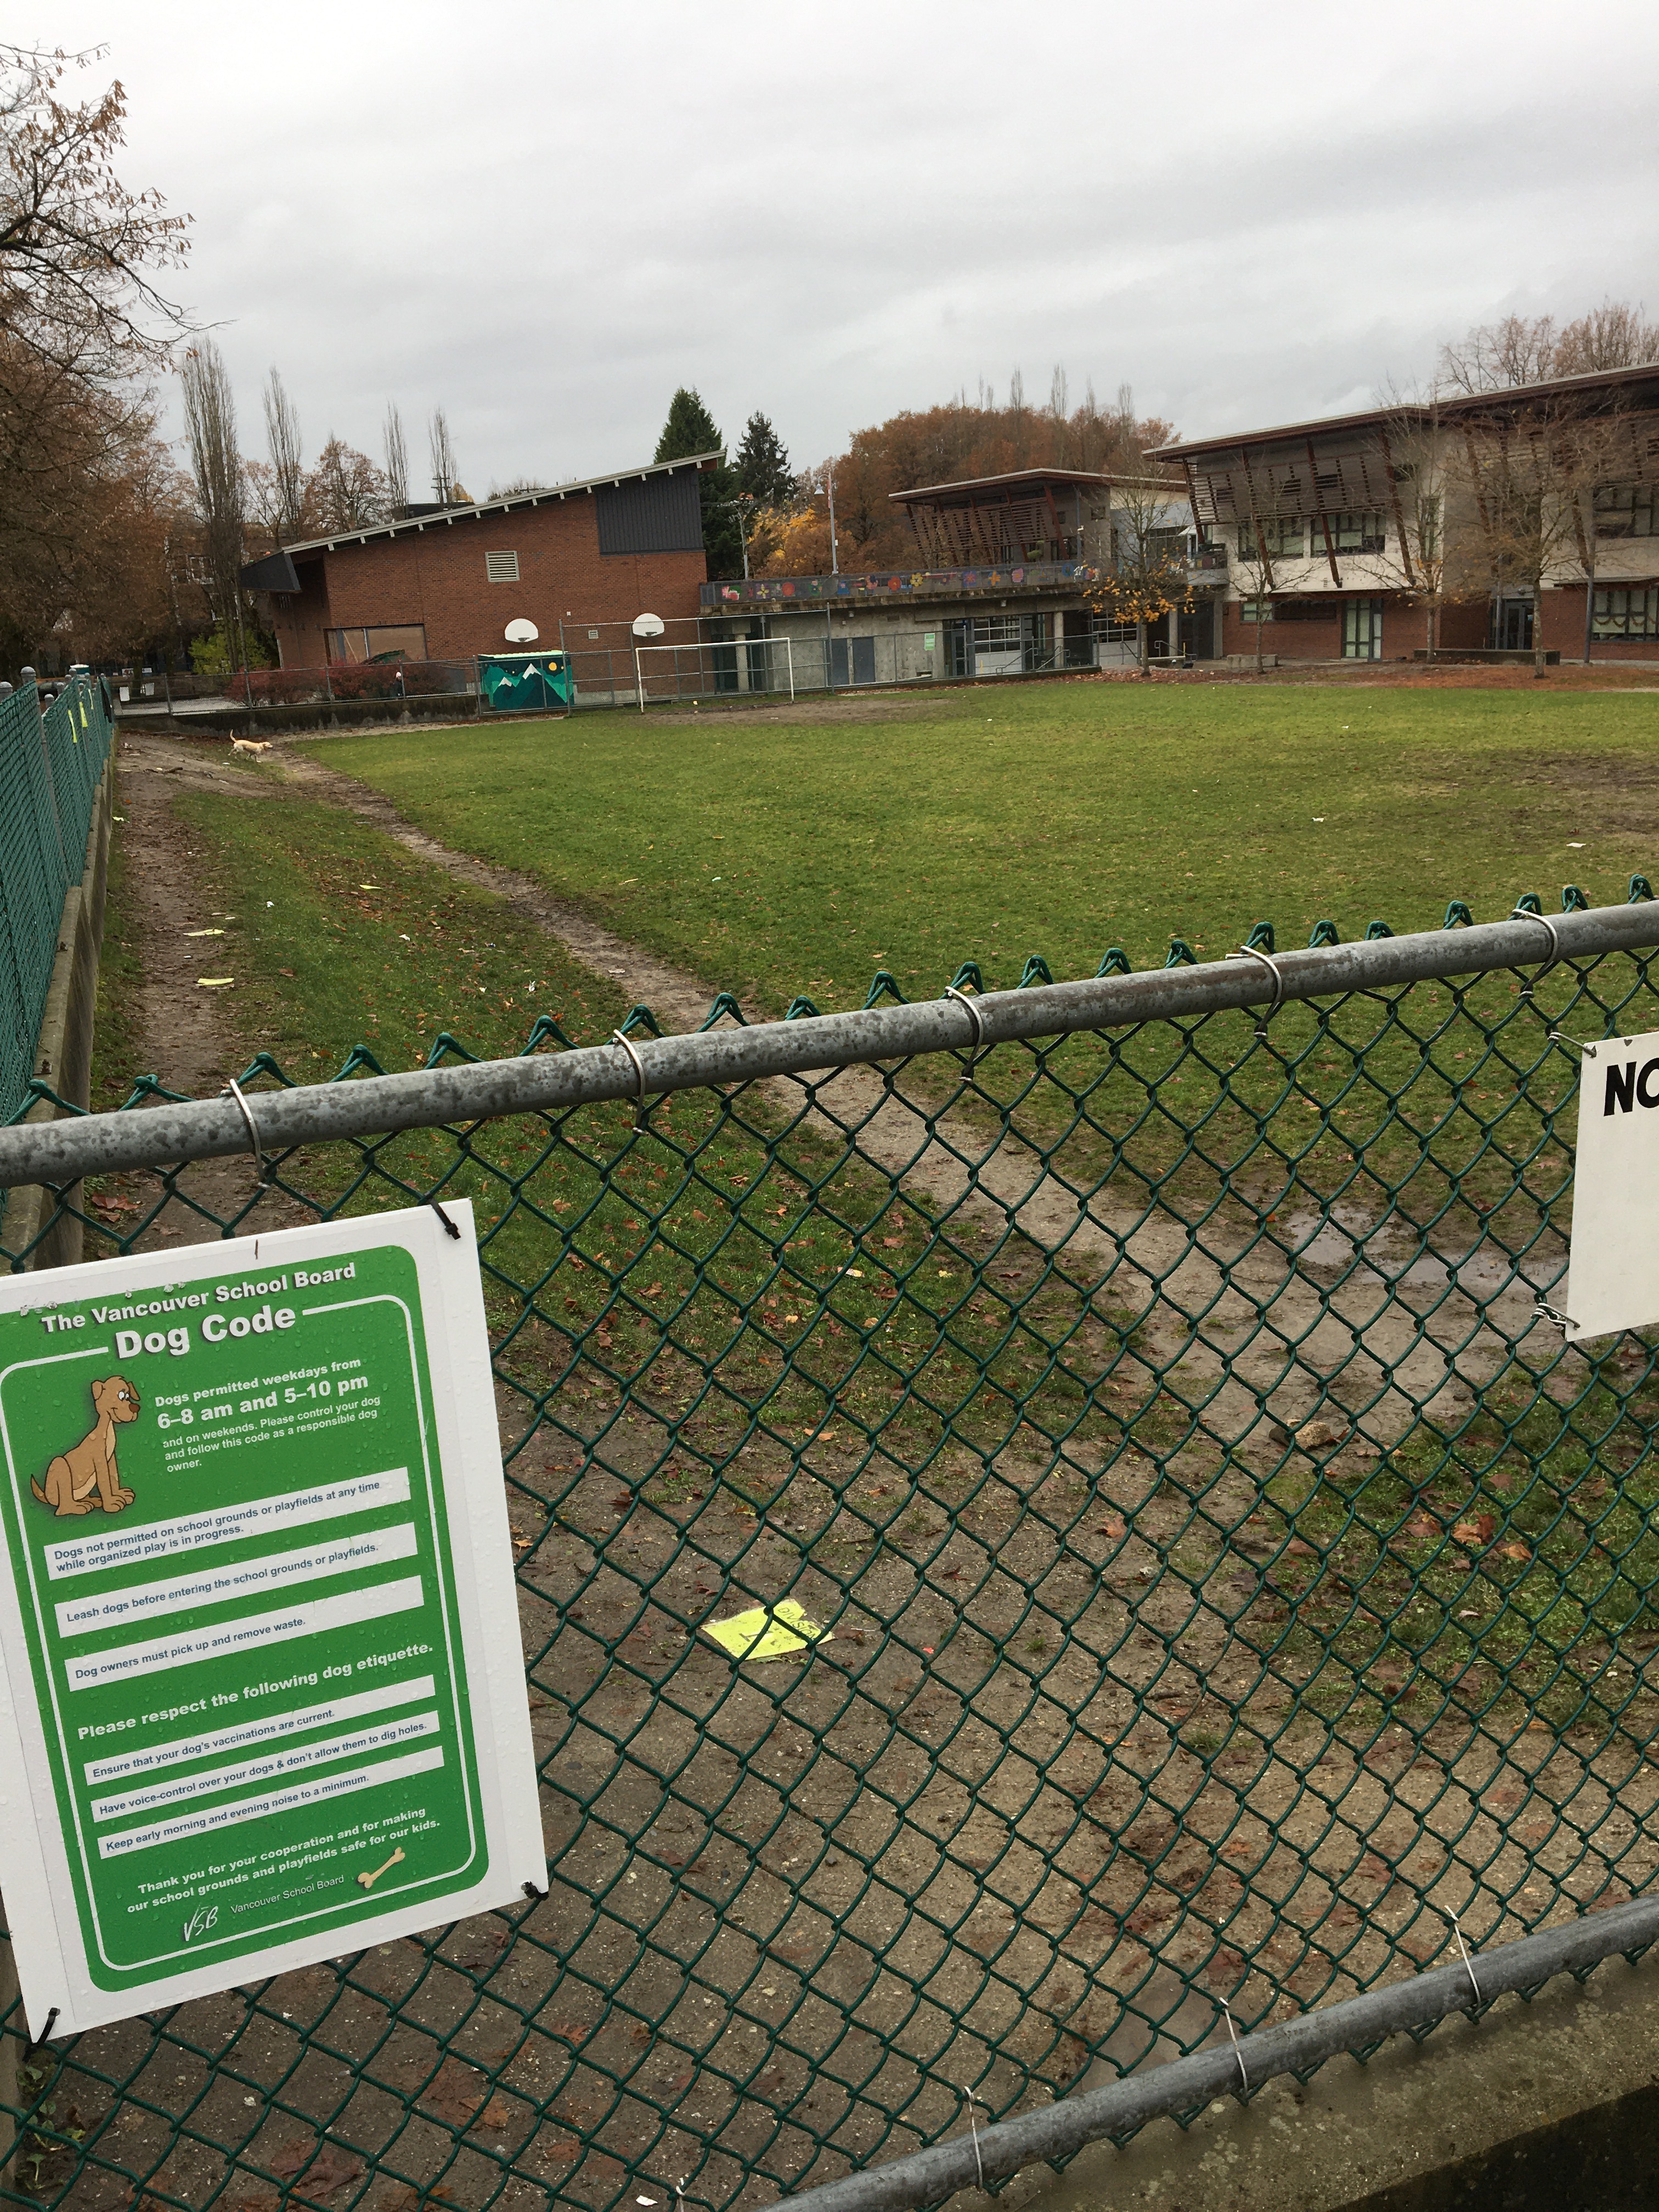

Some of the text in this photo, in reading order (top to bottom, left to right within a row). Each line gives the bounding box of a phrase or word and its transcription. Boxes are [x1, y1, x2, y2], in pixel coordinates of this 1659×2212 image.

[41, 1262, 356, 1333] The Vancouver School Board
[115, 1305, 296, 1359] Dog Code
[155, 1359, 361, 1407] Dogs permitted weekdays from
[200, 1404, 233, 1421] am
[240, 1391, 278, 1413] and
[337, 1376, 368, 1397] pm
[162, 1397, 381, 1448] and on weekends. Please control your dog
[165, 1448, 185, 1460] and
[187, 1443, 219, 1455] follow
[222, 1437, 242, 1448] this
[245, 1432, 270, 1444] code
[273, 1429, 285, 1438] as
[296, 1413, 356, 1433] responsible
[358, 1409, 377, 1420] dog
[167, 1459, 202, 1472] owner.
[54, 1482, 380, 1560] Dogs not permitted on school grounds or playfields at any time
[56, 1526, 244, 1572] while organized play is in progress.
[66, 1544, 379, 1622] Leash dogs before entering the school grounds or playfields.
[75, 1618, 306, 1679] Dog owners must pick up and remove waste.
[77, 1644, 433, 1740] Please respect the following dog etiquette.
[93, 1763, 130, 1778] Ensure
[133, 1756, 154, 1768] that
[155, 1750, 179, 1764] your
[212, 1725, 276, 1747] vaccinations
[279, 1721, 294, 1730] are
[297, 1709, 335, 1725] current.
[99, 1803, 126, 1815] Have
[128, 1782, 196, 1807] voice-control
[199, 1778, 221, 1789] over
[223, 1771, 246, 1785] your
[249, 1764, 274, 1776] dogs
[276, 1760, 285, 1769] &
[314, 1746, 340, 1758] allow
[342, 1739, 366, 1751] them
[381, 1731, 396, 1740] dig
[398, 1724, 427, 1736] holes.
[106, 1838, 133, 1851] Keep
[136, 1831, 161, 1843] early
[163, 1819, 206, 1836] morning
[208, 1812, 228, 1824] and
[230, 1802, 269, 1818] evening
[272, 1795, 298, 1807] noise
[322, 1776, 369, 1793] minimum.
[127, 1820, 440, 1912] our school grounds and playfields safe for our kids.
[138, 1808, 426, 1894] Thank you for your cooperation and for making
[183, 1905, 218, 1942] VSB
[230, 1875, 344, 1914] Vancouver School Board
